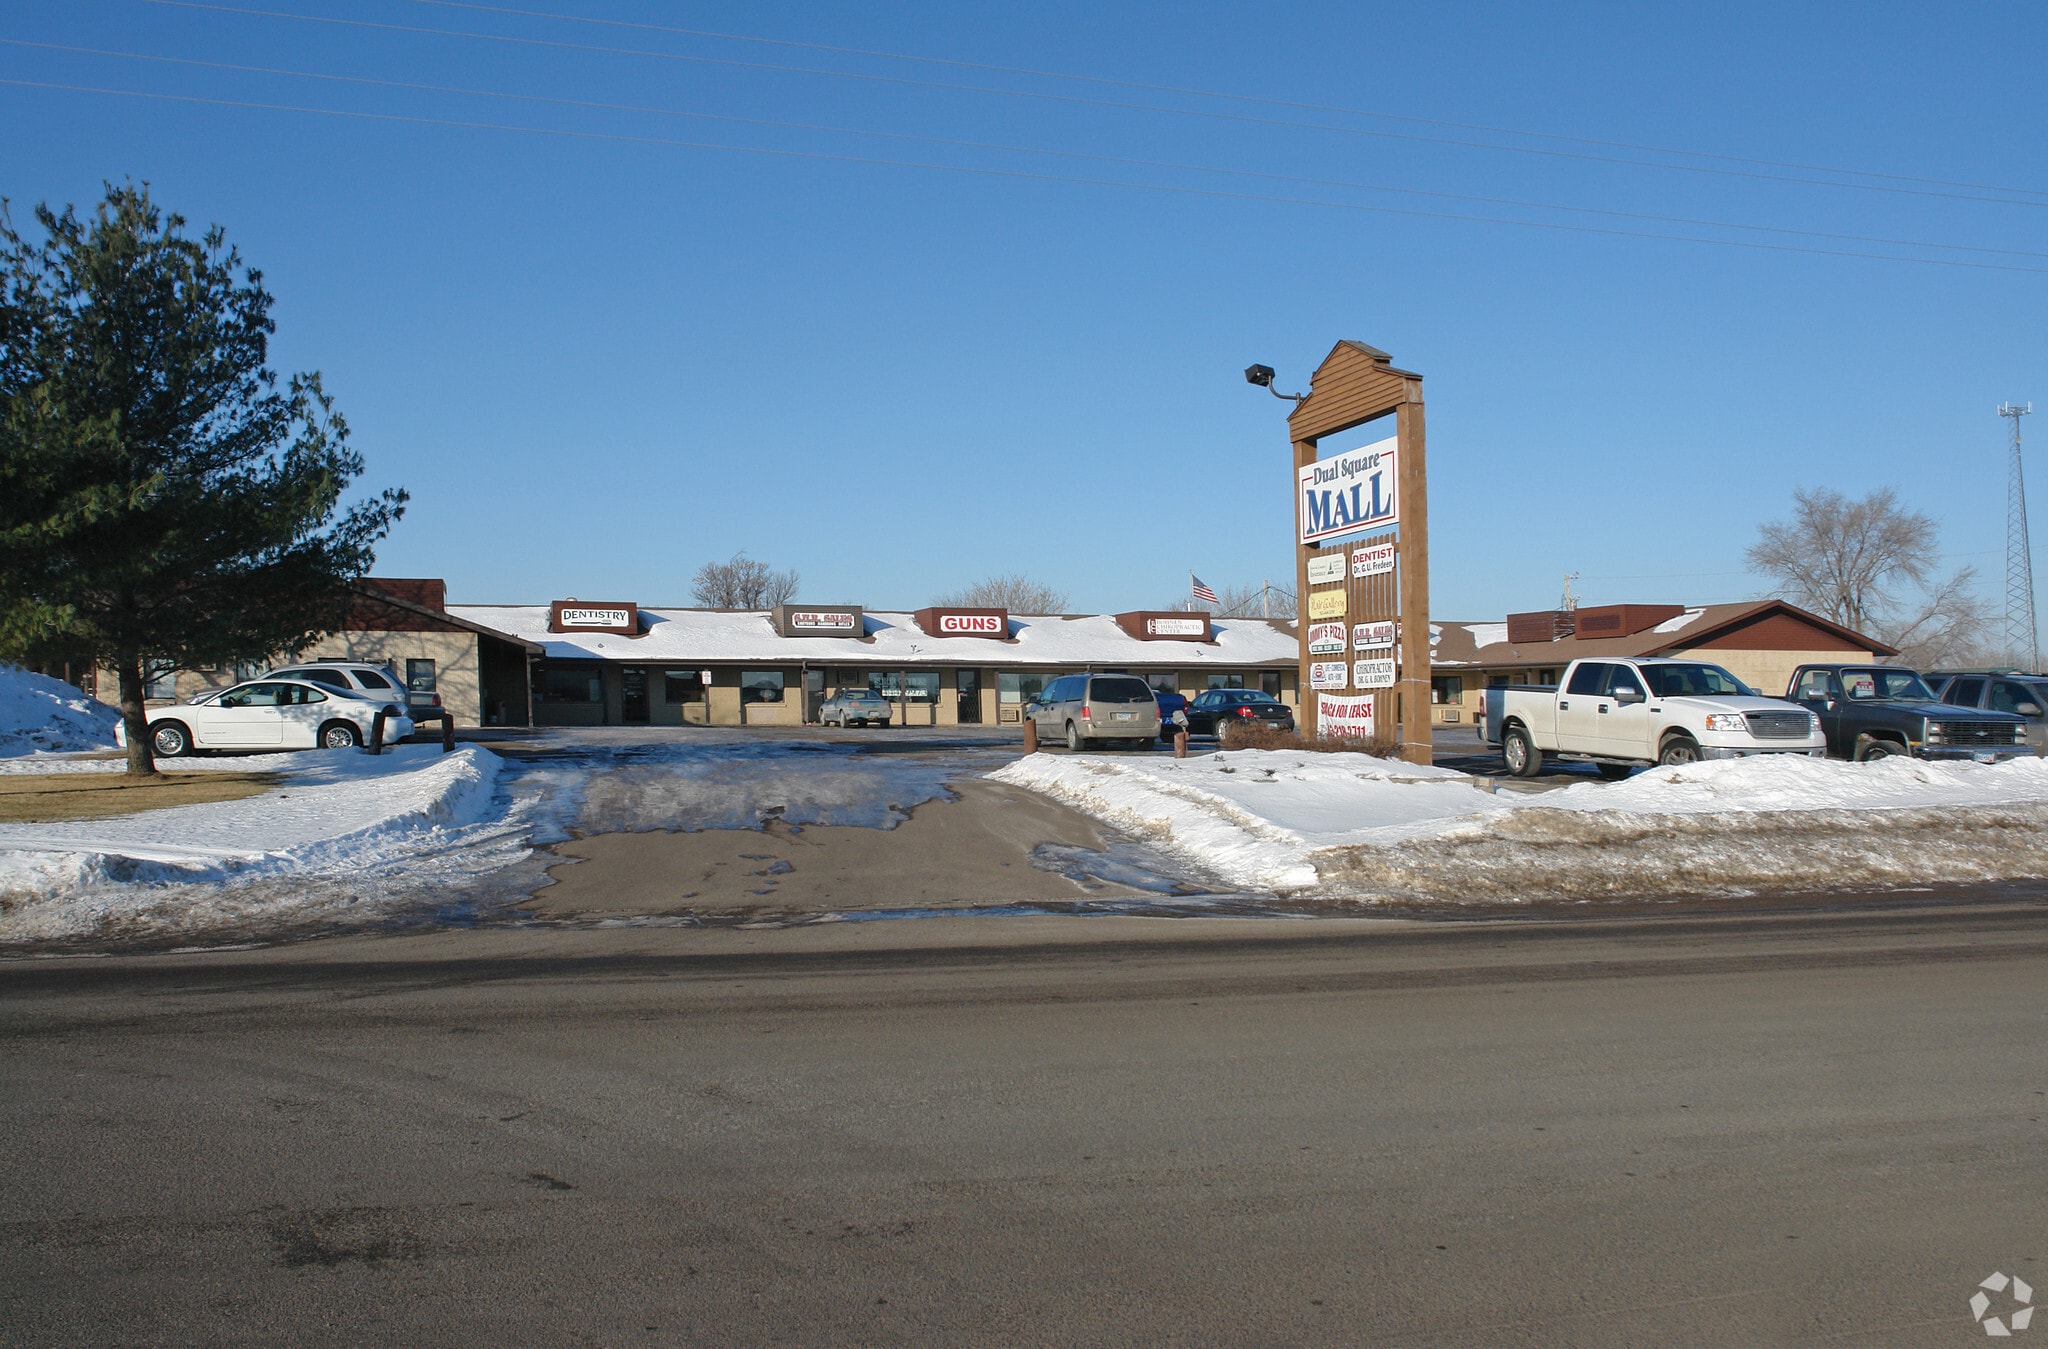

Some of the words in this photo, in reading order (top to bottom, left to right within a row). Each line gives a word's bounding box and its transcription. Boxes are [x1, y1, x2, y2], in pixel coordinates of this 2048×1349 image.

[1313, 460, 1339, 485] Dual
[1341, 452, 1380, 480] Square
[1306, 470, 1391, 535] MALL
[1353, 547, 1392, 564] DENTIST
[1353, 565, 1361, 574] Dr.
[1372, 560, 1392, 571] Fredeen
[563, 610, 626, 620] DENTISTRY
[823, 614, 853, 622] SALES
[944, 618, 998, 630] GUNS
[1329, 625, 1345, 640] PIZZA
[1356, 662, 1392, 674] CHIROPRACTOR
[1348, 703, 1372, 718] LEASE
